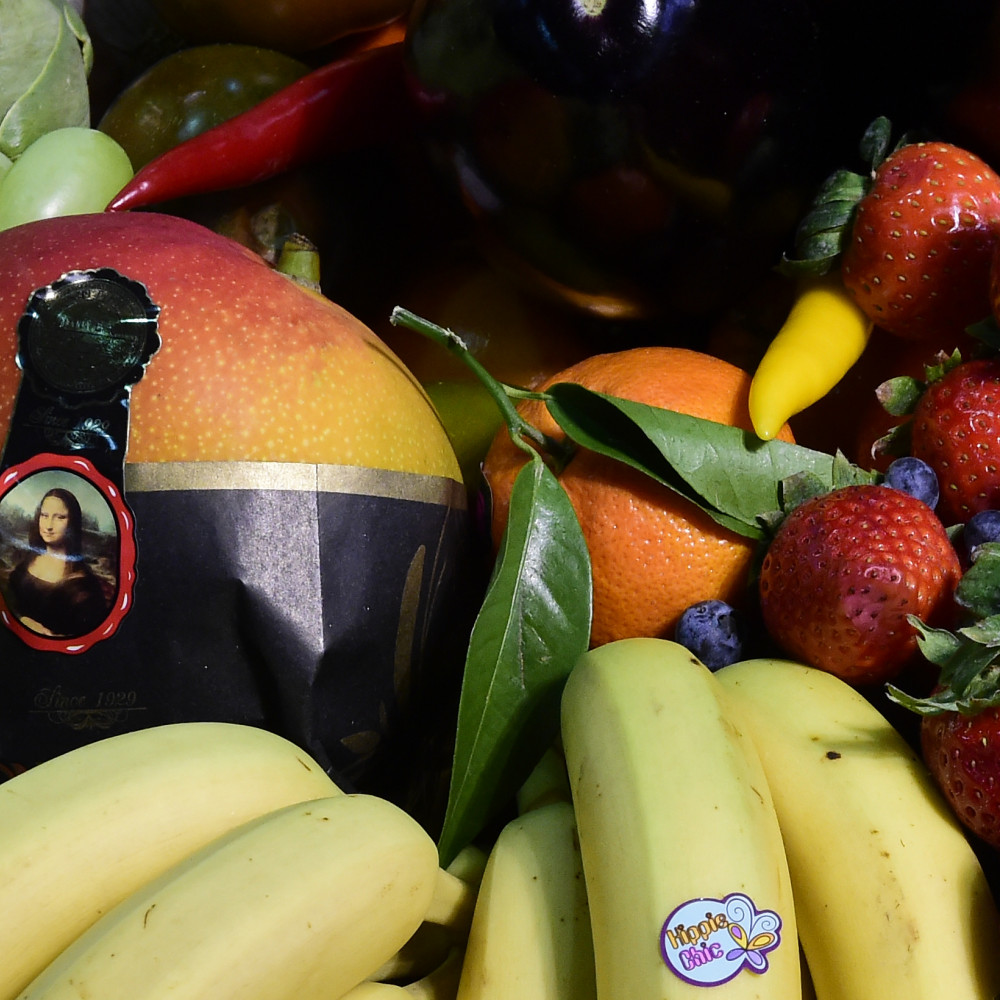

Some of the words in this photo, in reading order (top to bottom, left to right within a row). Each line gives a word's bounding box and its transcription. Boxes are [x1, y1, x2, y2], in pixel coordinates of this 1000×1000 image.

[33, 684, 87, 708] Since
[94, 690, 137, 708] 1929
[666, 912, 729, 949] Hippie
[679, 942, 724, 971] Chic
